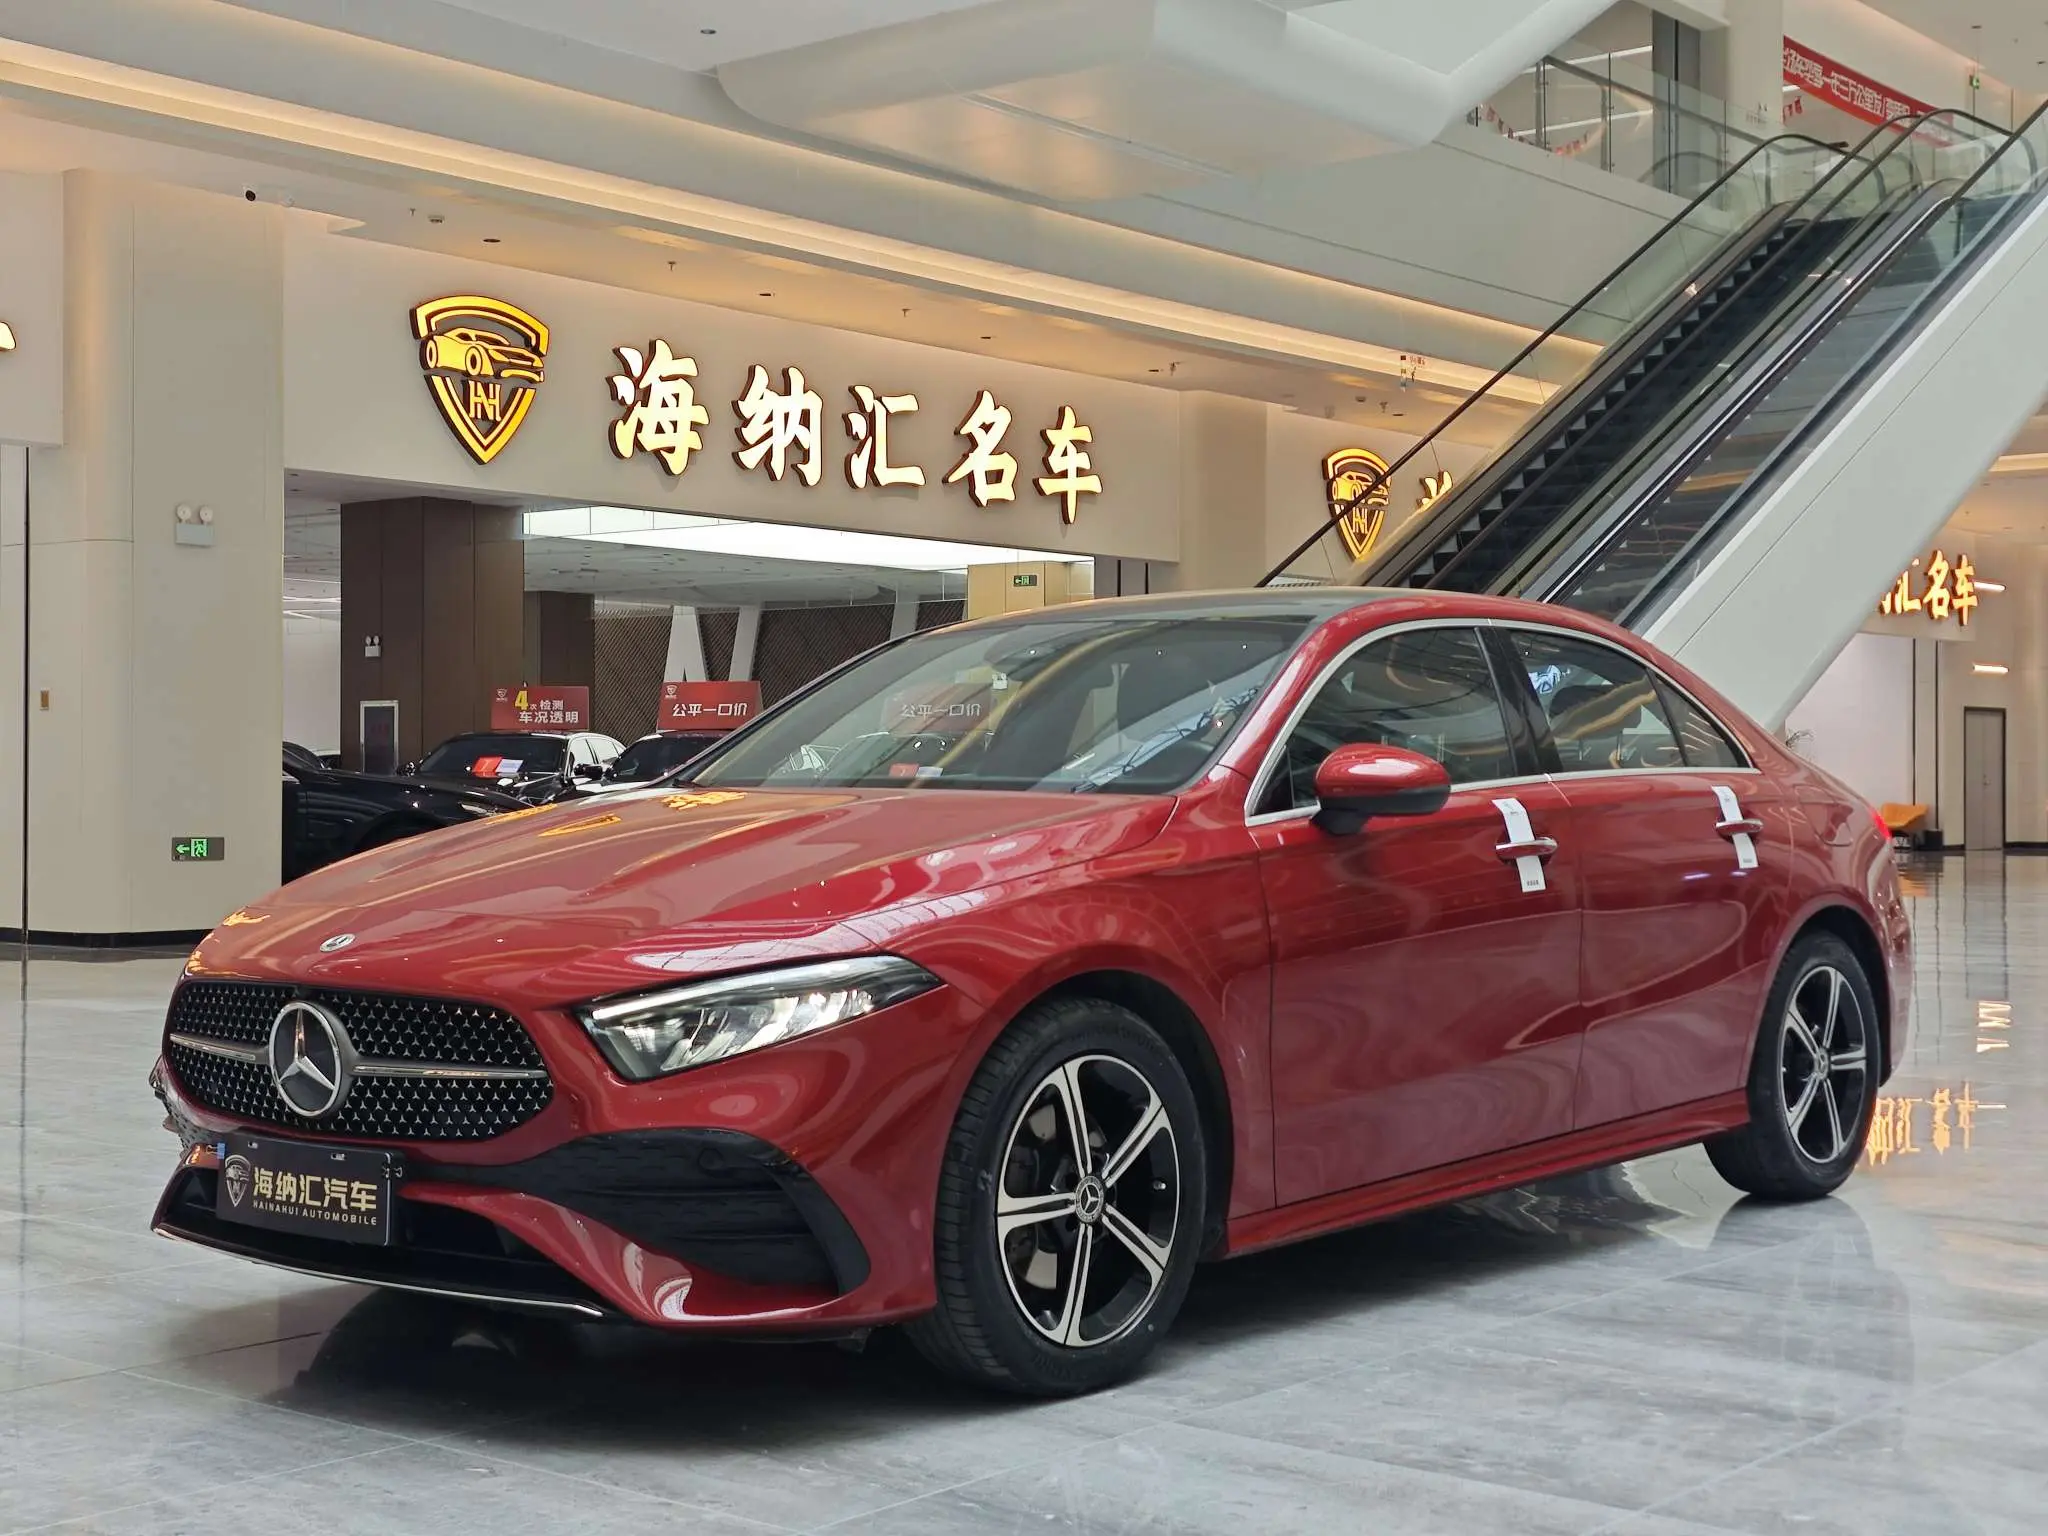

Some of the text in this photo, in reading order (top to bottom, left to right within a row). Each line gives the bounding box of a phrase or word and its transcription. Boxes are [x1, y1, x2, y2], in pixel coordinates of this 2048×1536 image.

[606, 339, 1103, 524] 海纳汇名车
[1880, 549, 1978, 626] 汇名车
[519, 710, 579, 724] 车况透明
[672, 702, 748, 718] 公平一口价
[900, 702, 982, 720] 公平一口价
[252, 1166, 378, 1211] 海纳汇汽车
[252, 1200, 377, 1225] HAINAHUI AUTOMOBILE
